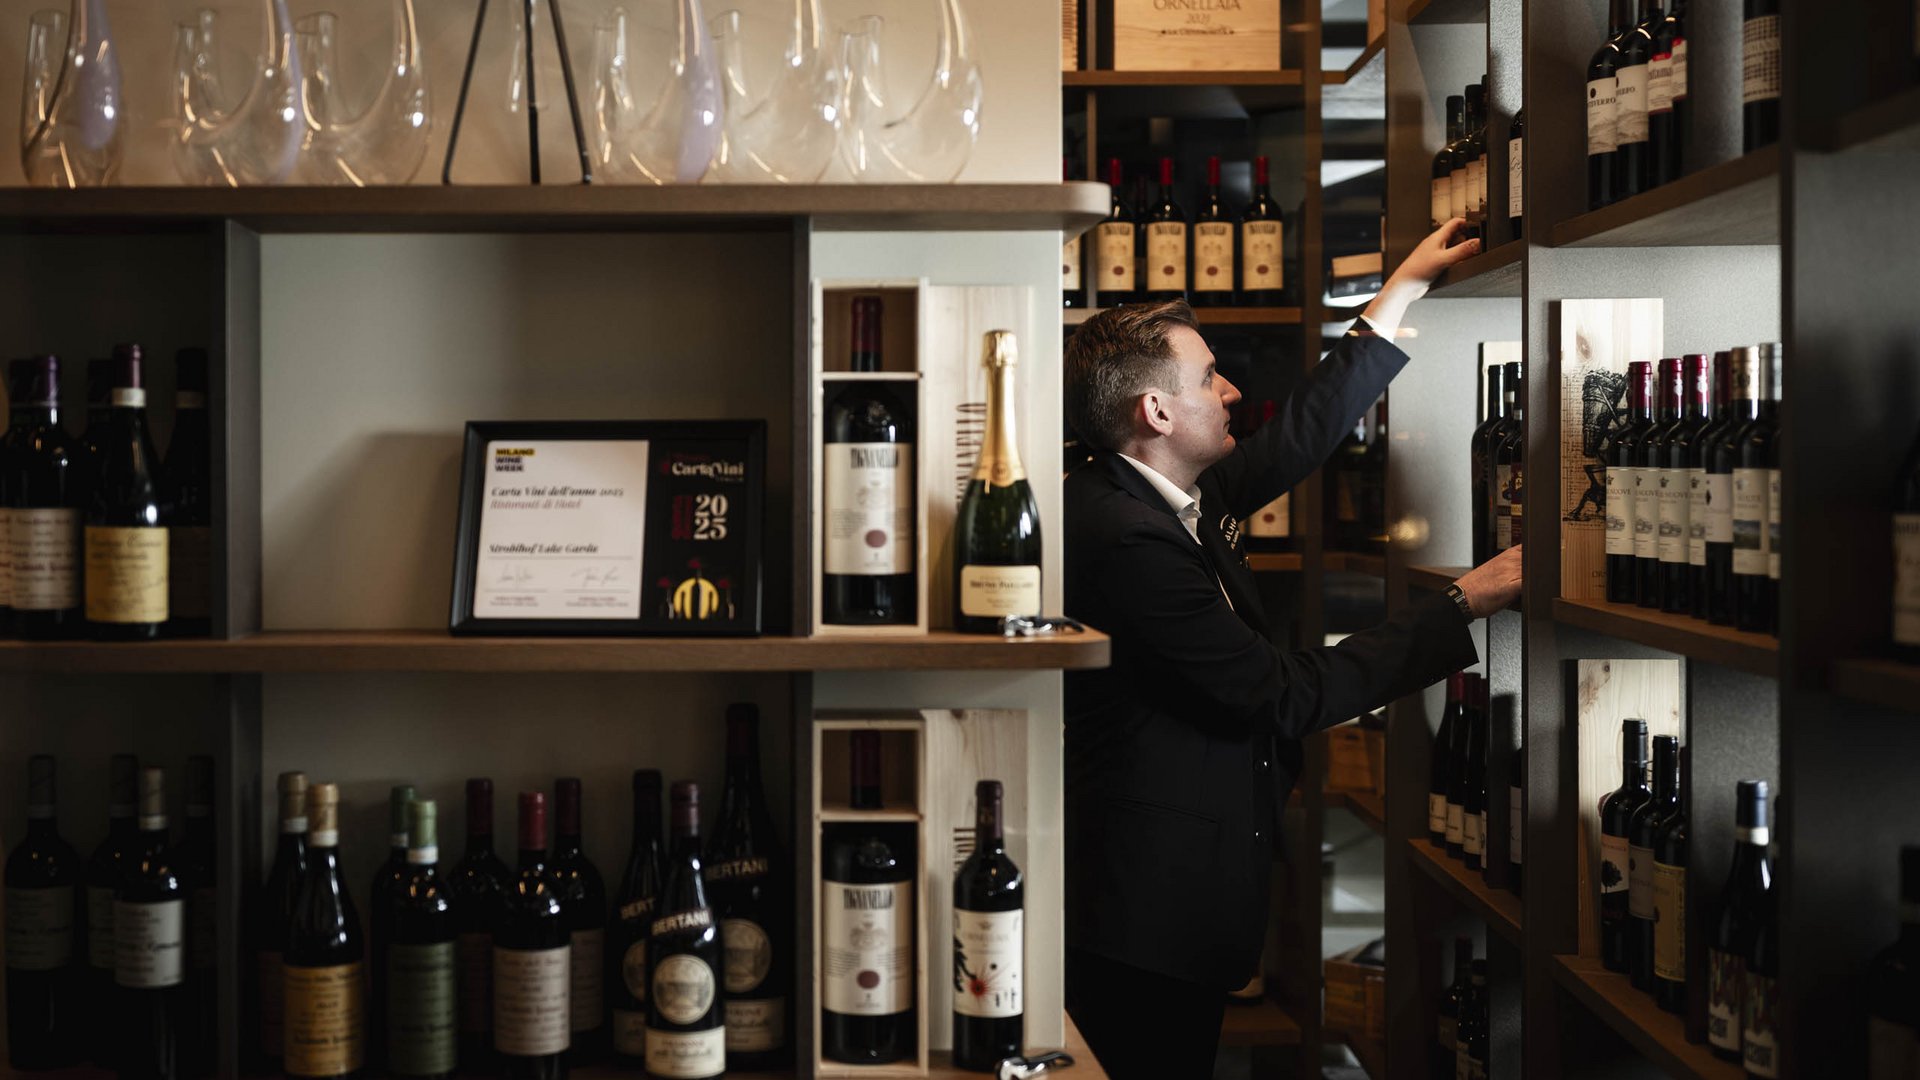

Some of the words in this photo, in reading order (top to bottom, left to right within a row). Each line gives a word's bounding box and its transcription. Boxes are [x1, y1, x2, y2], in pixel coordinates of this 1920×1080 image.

[496, 448, 535, 456] MILANO
[694, 494, 729, 517] 20
[693, 517, 728, 541] 25
[843, 888, 893, 910] TIGNANELLO
[651, 908, 710, 936] BERTANI
